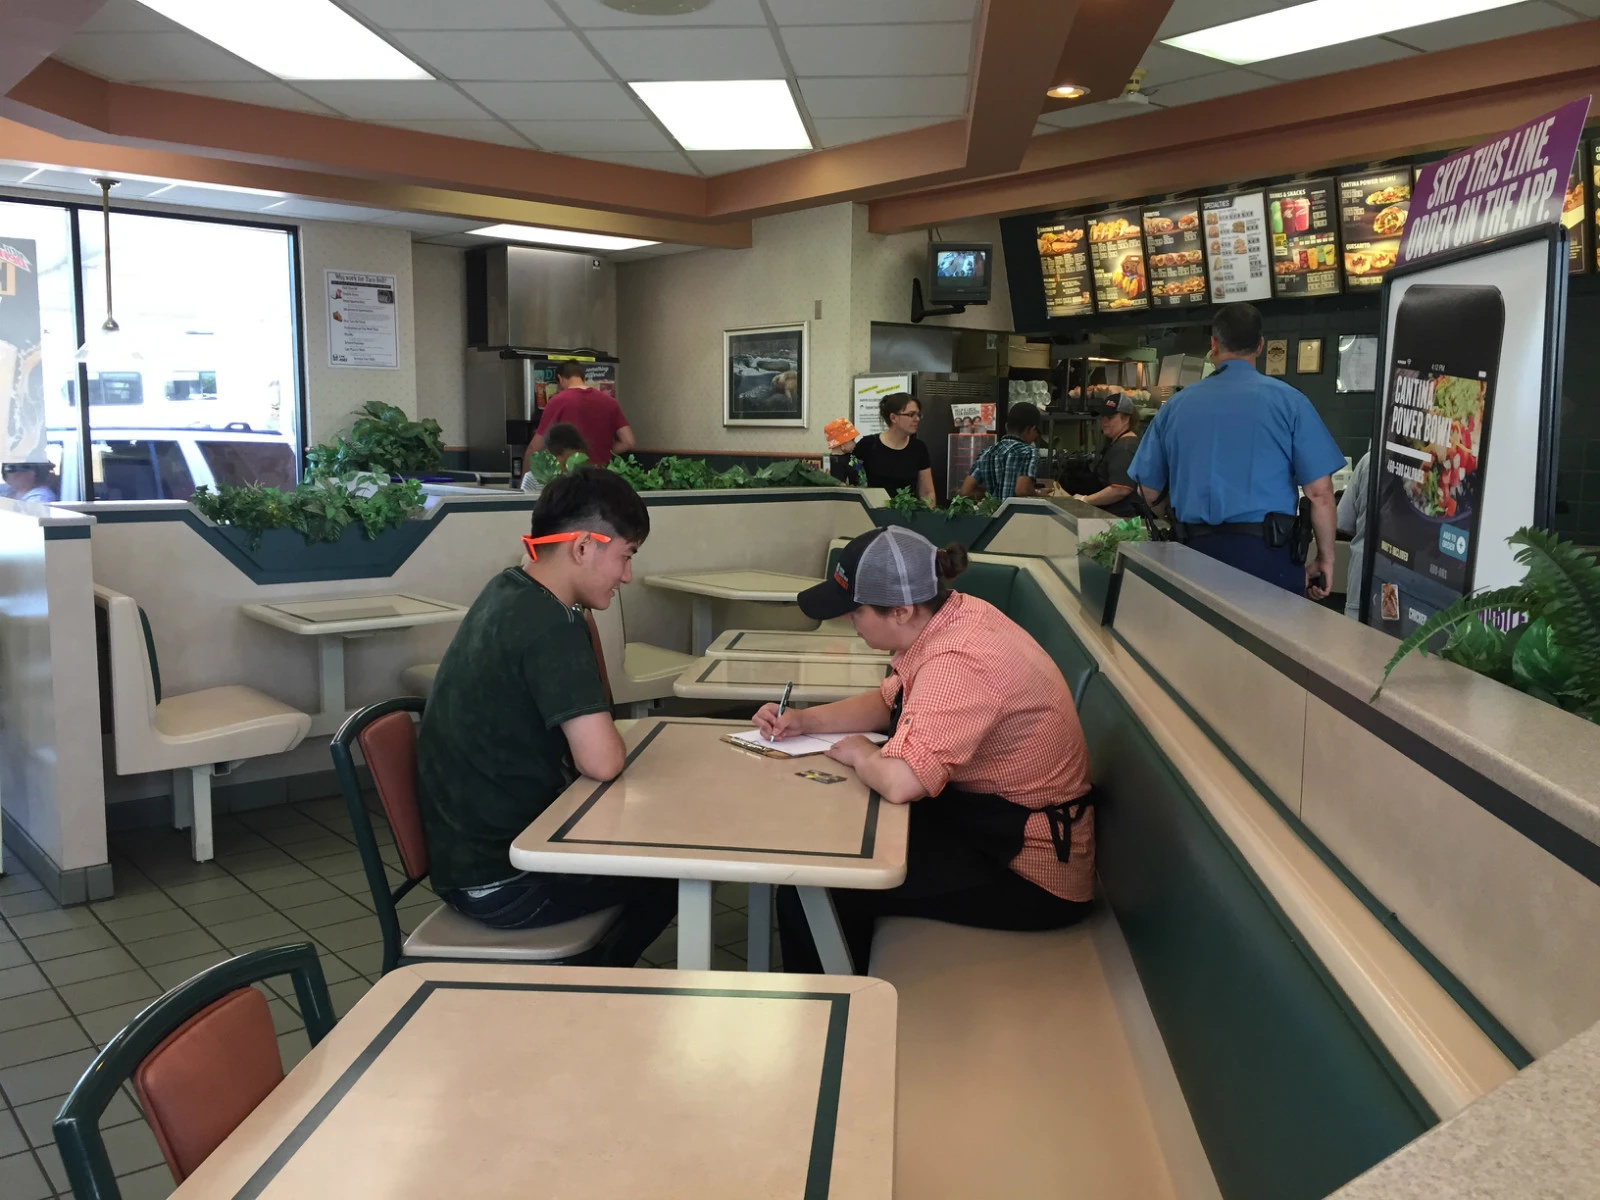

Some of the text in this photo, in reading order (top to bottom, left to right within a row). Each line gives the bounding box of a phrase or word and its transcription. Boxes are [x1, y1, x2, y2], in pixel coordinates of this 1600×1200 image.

[1427, 154, 1471, 210] SKIP
[1464, 136, 1511, 195] THIS
[1504, 116, 1556, 180] LINE.
[1405, 205, 1458, 261] ORDER
[1453, 195, 1485, 247] ON
[1480, 182, 1519, 239] THE
[1512, 168, 1558, 229] APP.
[1394, 375, 1434, 410] CANTINA
[1391, 406, 1452, 448] POWER BOWL
